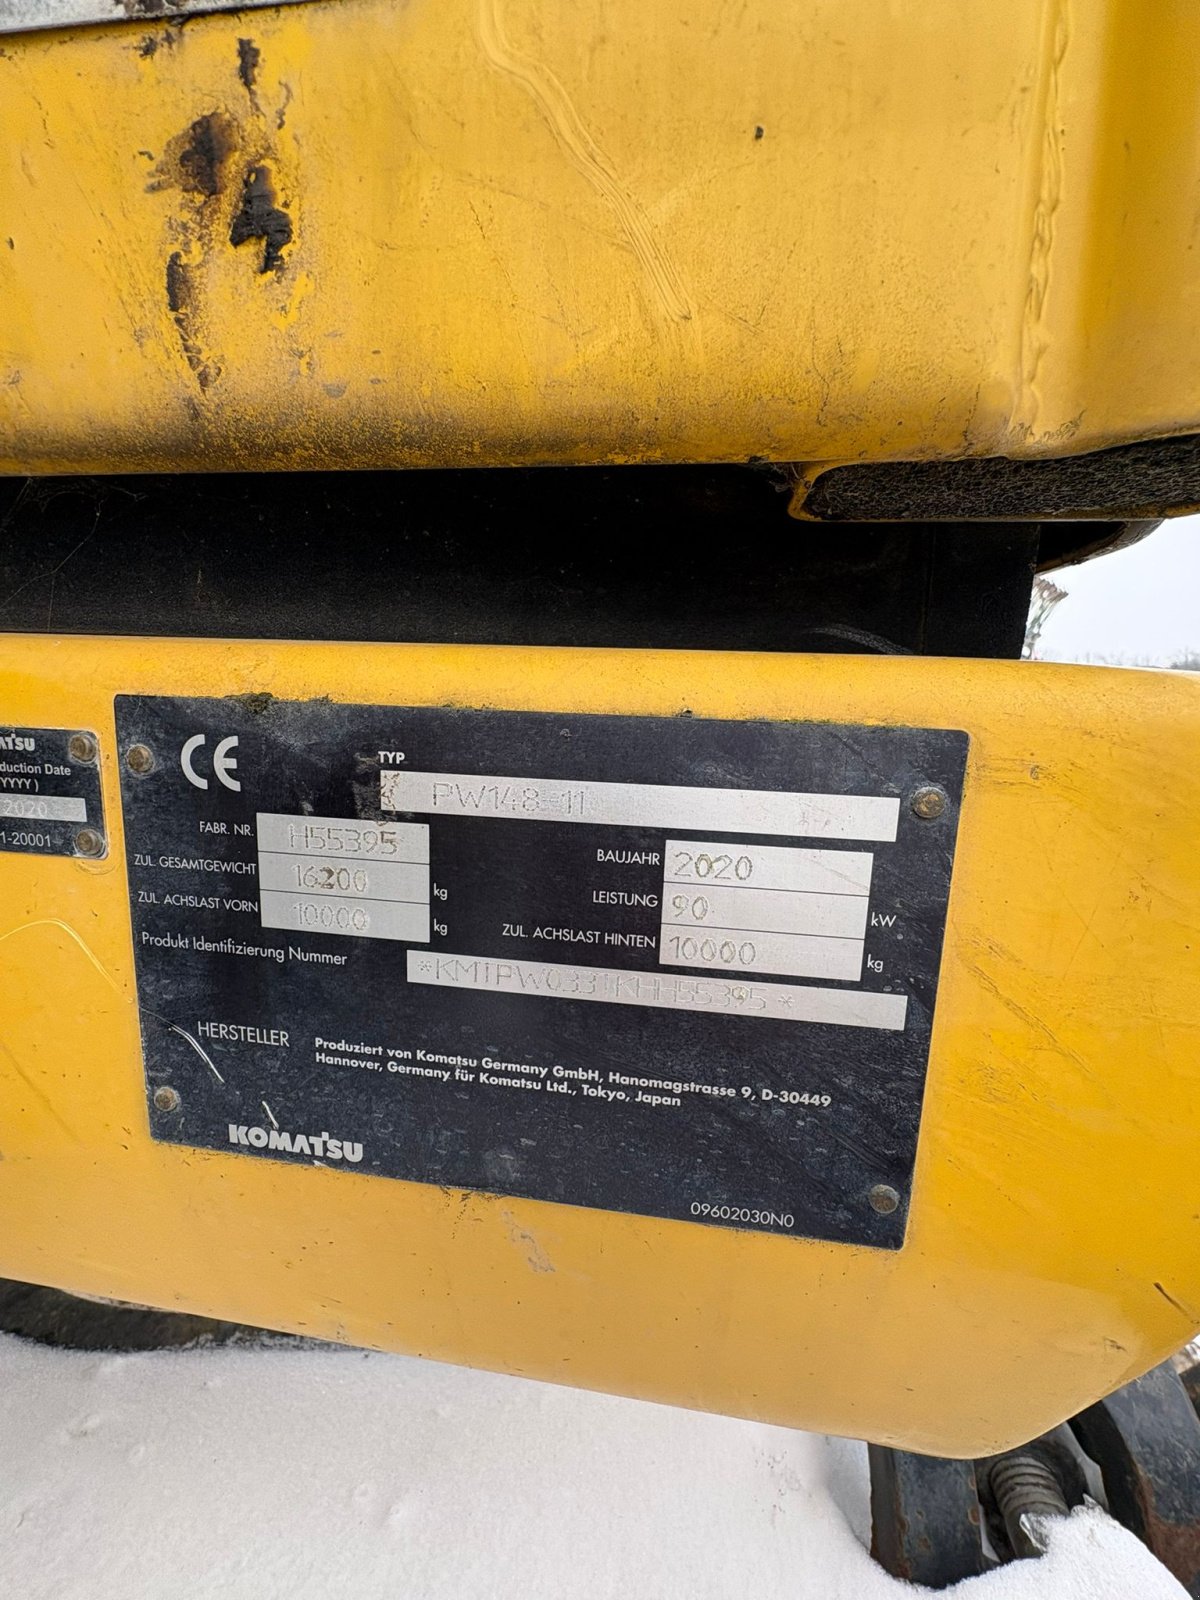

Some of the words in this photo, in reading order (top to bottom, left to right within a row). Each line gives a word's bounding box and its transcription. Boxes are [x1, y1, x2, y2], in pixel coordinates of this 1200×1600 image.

[44, 764, 71, 776] Date
[378, 751, 406, 765] TYP
[432, 782, 585, 815] PW148-11
[200, 821, 230, 836] FABR.
[234, 824, 255, 837] NR.
[288, 824, 399, 855] H55395
[159, 856, 257, 875] GESAMTGEWICHT
[596, 848, 661, 866] BAUJAHR
[673, 851, 753, 880] 2020
[292, 864, 368, 893] 16200
[433, 883, 448, 900] kg
[163, 894, 221, 910] ACHSLAST
[223, 899, 259, 913] VORN
[592, 890, 659, 908] LEISTUNG
[672, 895, 709, 920] 90
[293, 902, 370, 931] 10000
[433, 918, 448, 936] kg
[870, 911, 897, 928] kW
[142, 932, 189, 951] Produkt
[192, 936, 285, 963] Identifizierung
[289, 946, 348, 966] Nummer
[502, 923, 529, 938] ZUL.
[533, 926, 601, 944] ACHSLAST
[604, 933, 656, 949] HINTEN
[668, 935, 756, 965] 10000
[867, 953, 884, 973] kg
[197, 1021, 290, 1047] HERSTELLER
[315, 1037, 384, 1056] Produziert
[387, 1048, 412, 1060] von
[416, 1050, 477, 1068] Komatsu
[481, 1057, 548, 1078] Germany
[552, 1065, 604, 1084] GmbH,
[608, 1071, 736, 1098] Hanomagstrasse
[741, 1086, 757, 1101] 9,
[761, 1088, 832, 1108] D-30449
[315, 1051, 383, 1073] Hannover,
[387, 1060, 451, 1082] Germany
[455, 1067, 475, 1083] für
[479, 1072, 542, 1091] Komatsu
[546, 1079, 577, 1097] Ltd.,
[582, 1084, 631, 1103] Tokyo,
[635, 1091, 681, 1107] Japan
[229, 1123, 364, 1163] KOMATSU
[690, 1202, 795, 1229] 09602030N0
